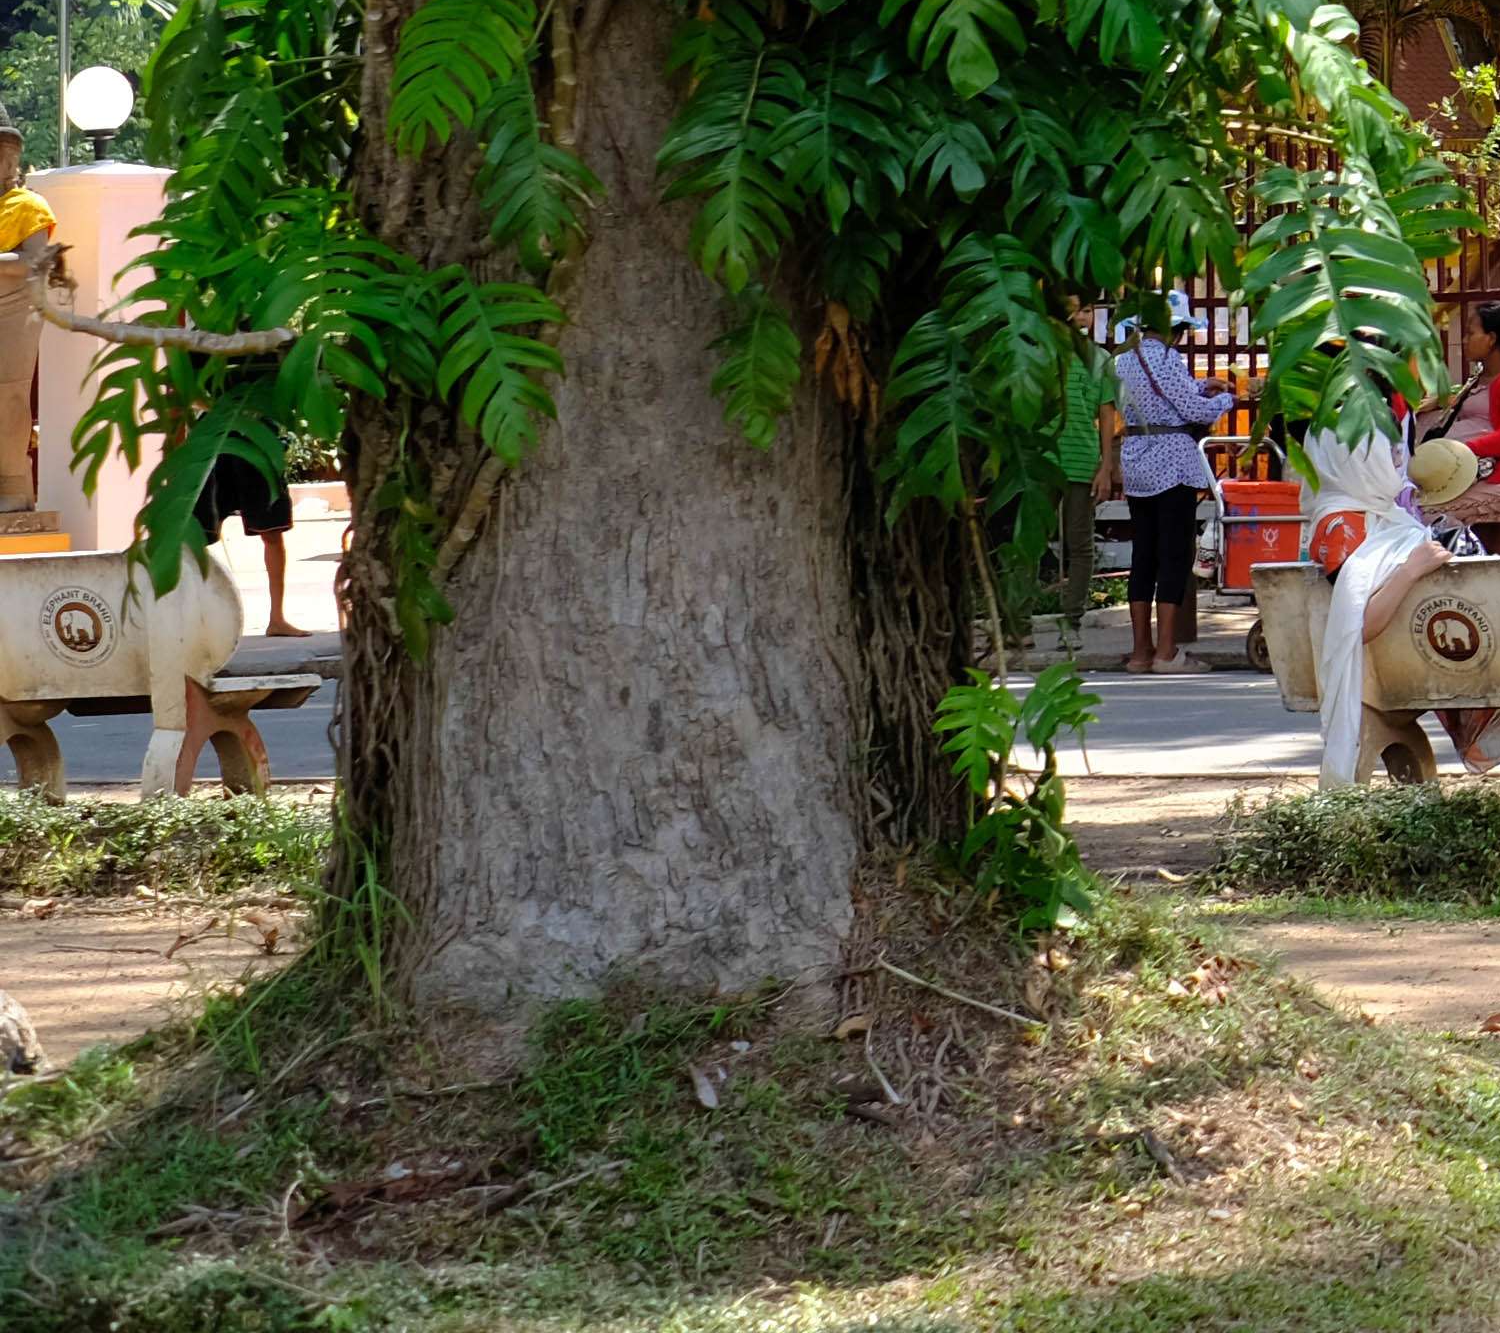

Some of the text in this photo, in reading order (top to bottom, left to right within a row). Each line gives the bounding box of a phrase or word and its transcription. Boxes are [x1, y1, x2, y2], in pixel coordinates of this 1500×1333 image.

[42, 590, 112, 625] ELEPHANT BRAND
[1415, 598, 1489, 634] ELEPHANT BRAND
